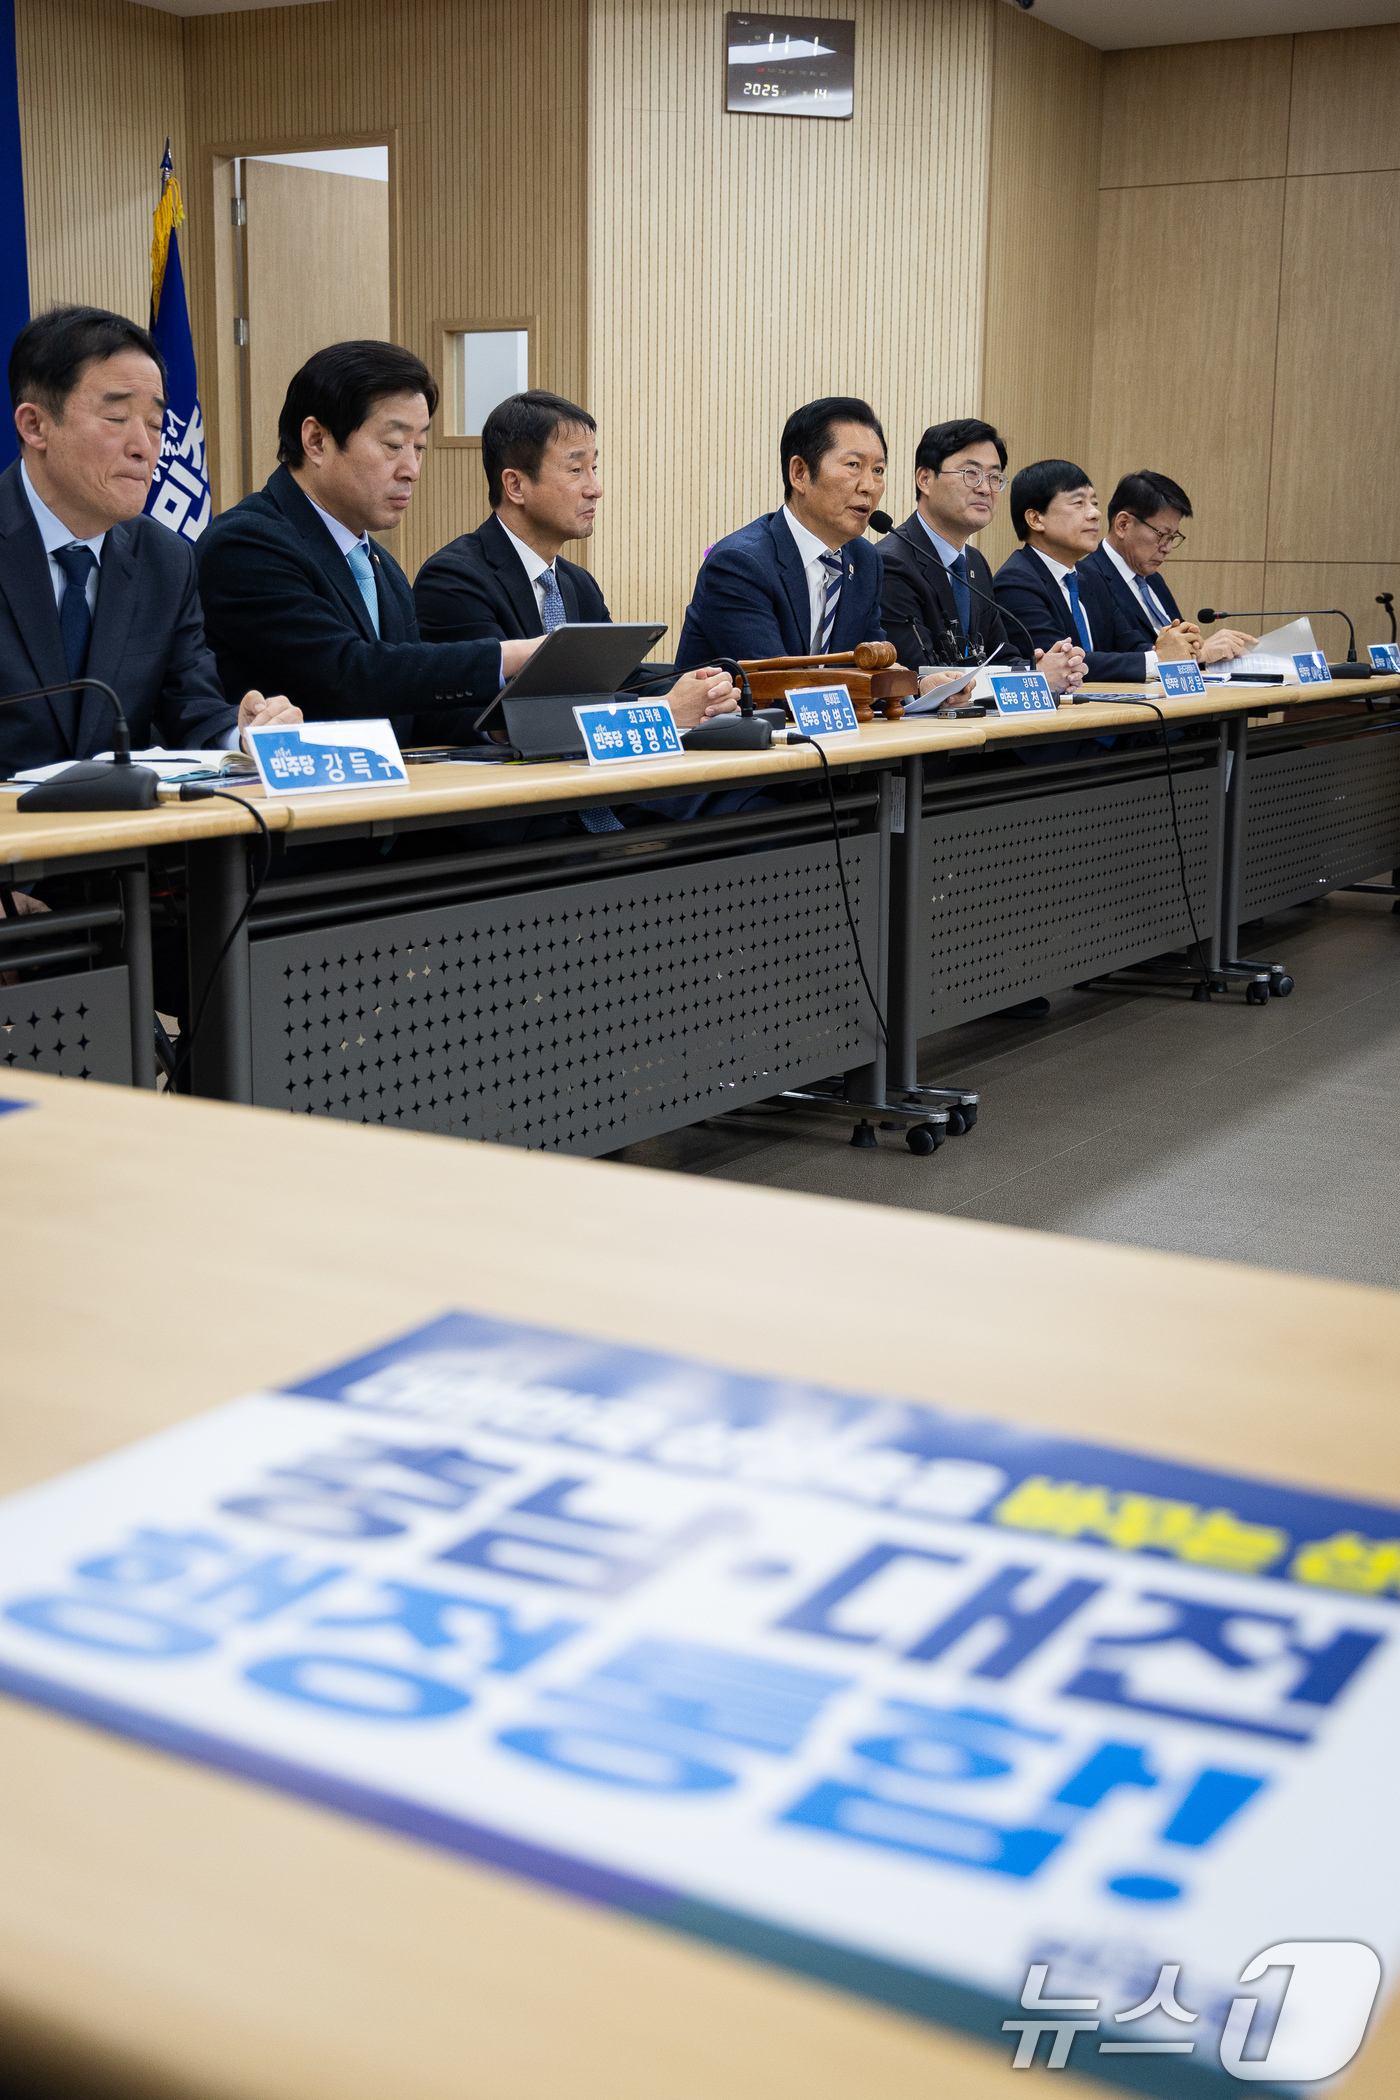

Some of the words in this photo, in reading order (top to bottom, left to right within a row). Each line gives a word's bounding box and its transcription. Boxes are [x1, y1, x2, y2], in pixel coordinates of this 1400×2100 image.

[743, 82, 779, 97] 2025
[814, 88, 828, 100] 14
[1022, 677, 1039, 688] 당대표
[999, 691, 1018, 705] 민주당
[1020, 690, 1052, 709] 정청래
[627, 708, 662, 724] 최고위원
[799, 710, 820, 727] 민주당
[821, 707, 855, 730] 한병도
[592, 729, 624, 750] 민주당
[626, 726, 677, 754] 황명선
[270, 755, 315, 778] 민주당
